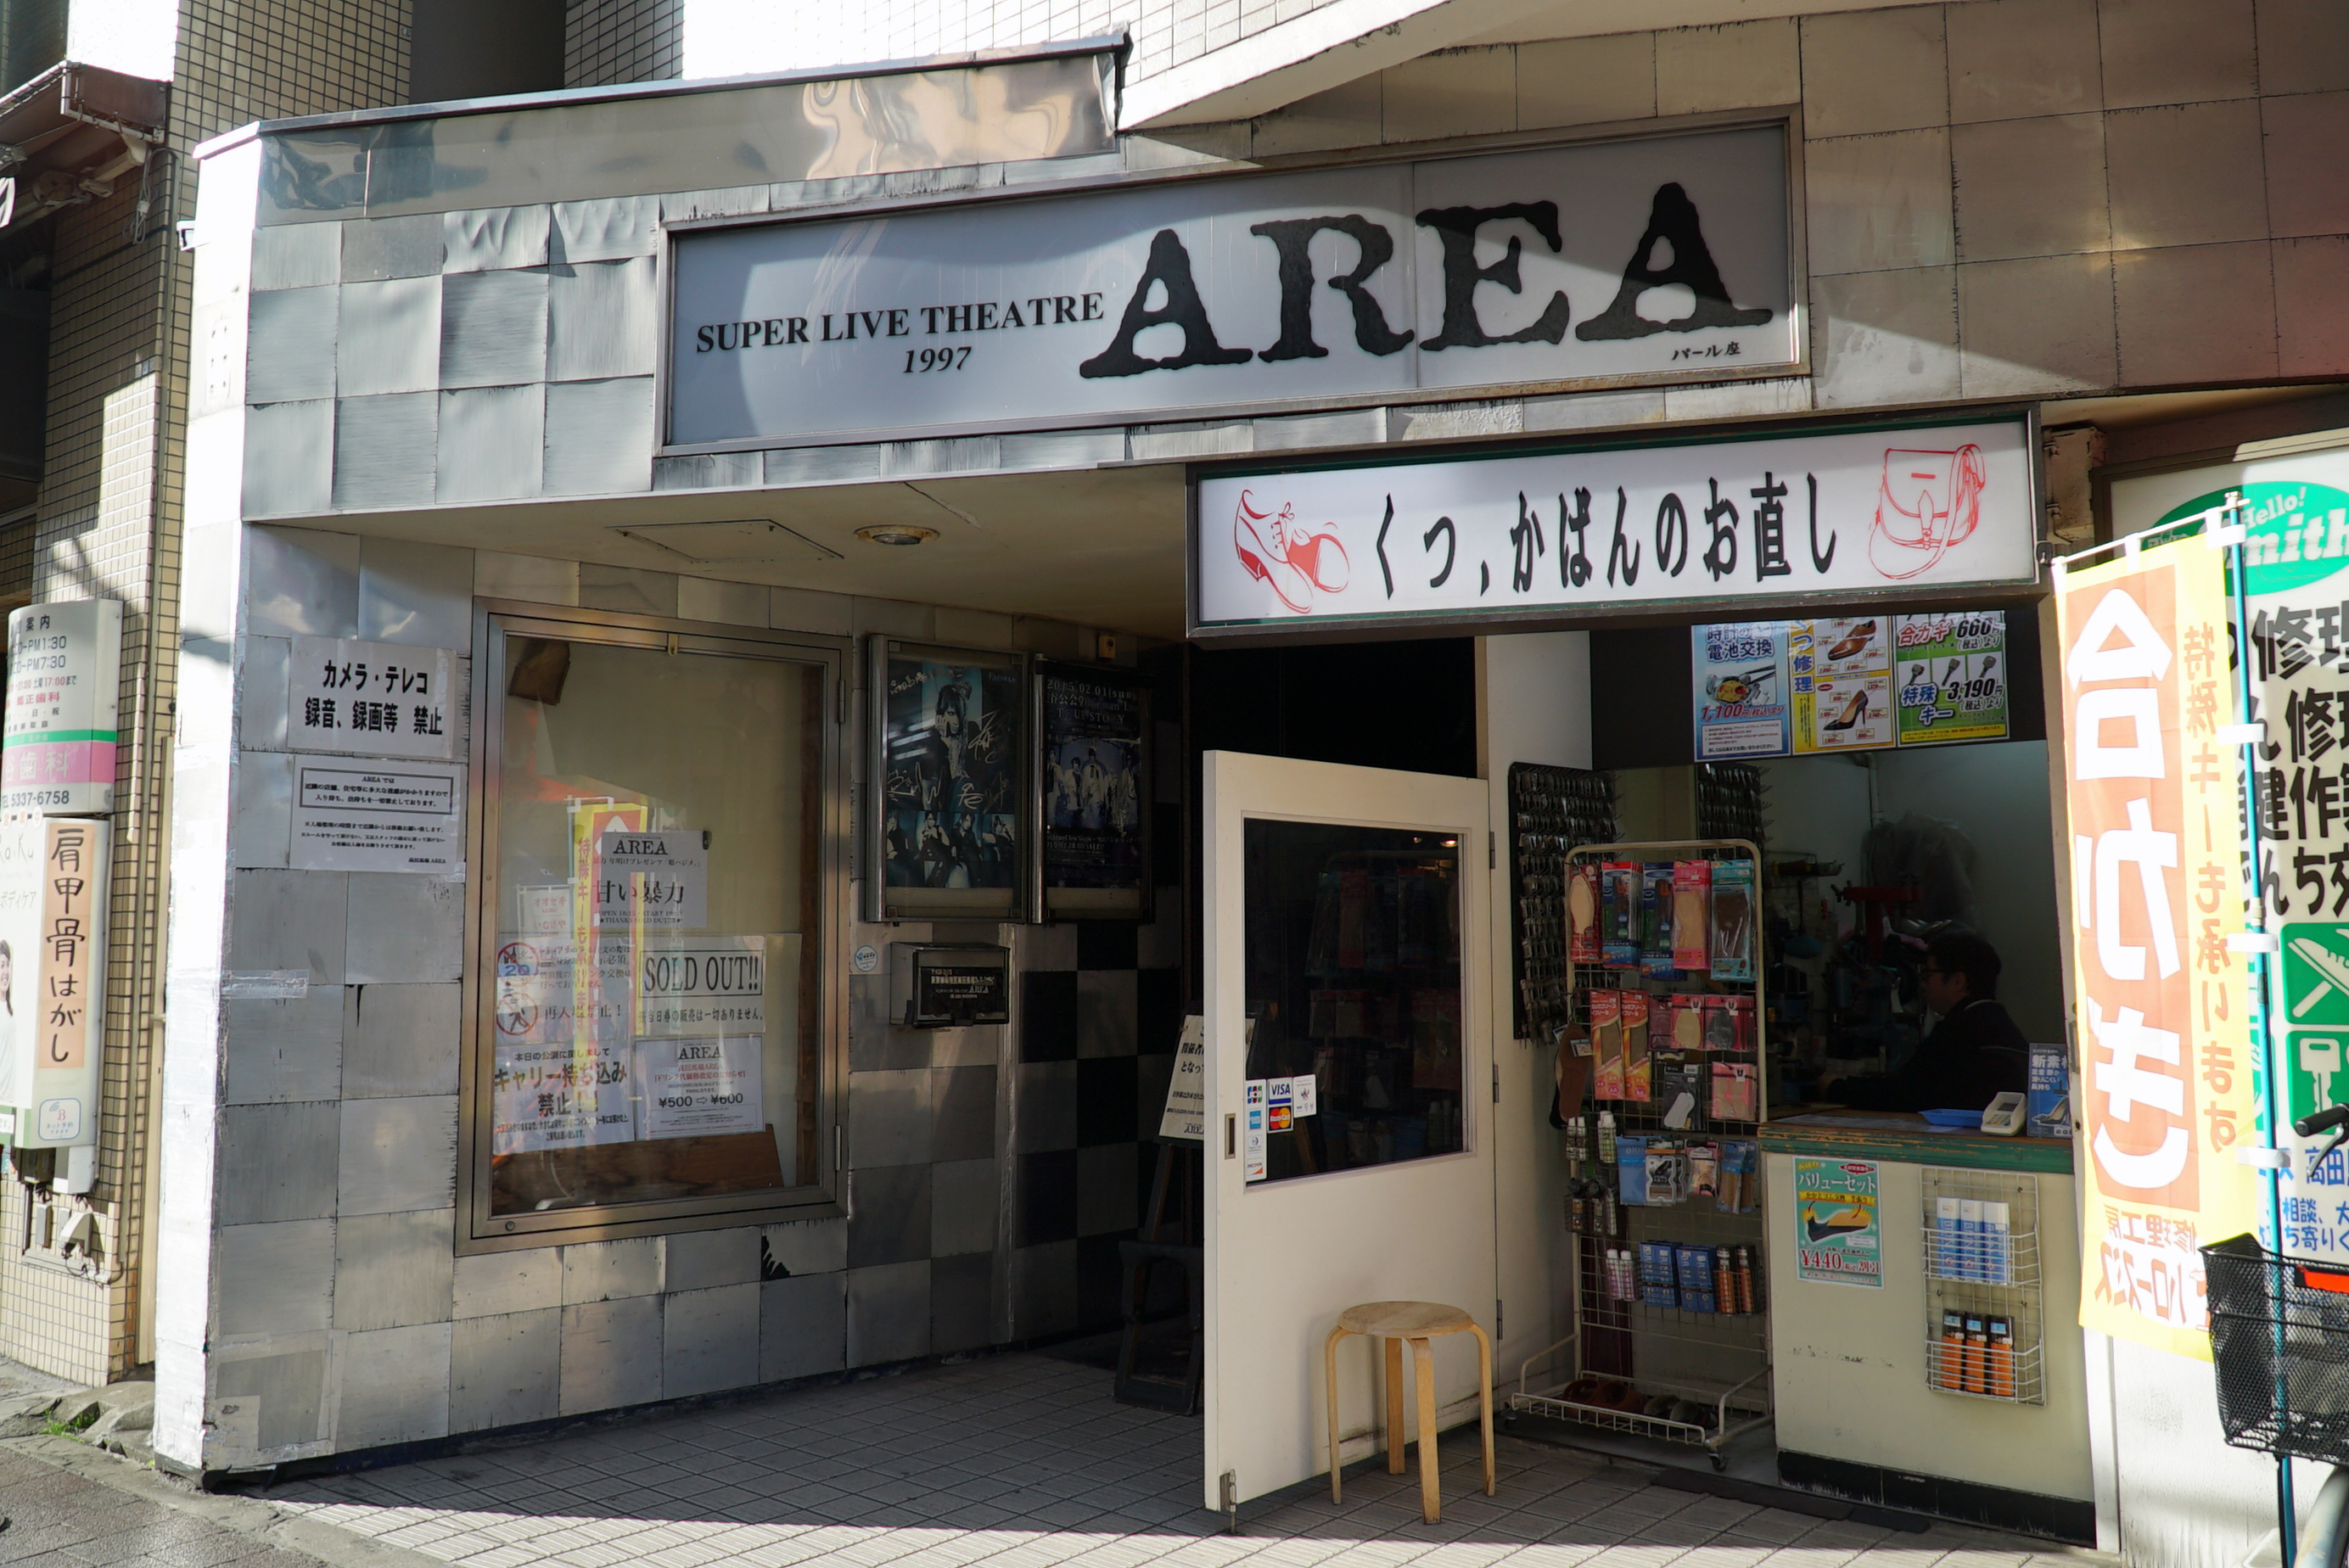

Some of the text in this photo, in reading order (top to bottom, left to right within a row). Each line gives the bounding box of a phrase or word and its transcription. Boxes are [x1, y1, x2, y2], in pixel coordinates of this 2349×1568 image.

[1080, 181, 1774, 379] AREA
[698, 292, 1106, 355] SUPER LIVE THEATRE
[903, 346, 973, 375] 1997
[2239, 486, 2307, 530] Hello!
[1376, 471, 1838, 599] くつ、かばんのお直し
[2225, 508, 2349, 568] mith
[1898, 619, 1952, 647] 合カギ
[1707, 639, 1774, 660] 電池交換
[322, 659, 428, 694] カメラ・テレコ
[1948, 677, 2004, 701] 3,190円
[1902, 684, 1937, 706] 特殊
[305, 697, 443, 736] 録音、録画等 禁止
[1919, 706, 1955, 725] キー
[2239, 686, 2349, 763] ん修
[11, 790, 70, 807] 5337-6758
[2239, 764, 2349, 843] 鍵作
[612, 839, 669, 856] AREA
[46, 827, 86, 1063] 肩甲骨はがし
[644, 955, 760, 992] SOLD OUT!!
[677, 1045, 724, 1061] AREA
[659, 1092, 744, 1109] ¥500 ¥600
[1270, 1083, 1291, 1096] VISA
[2305, 1145, 2349, 1185] 高田
[1800, 1249, 1842, 1271] ¥440
